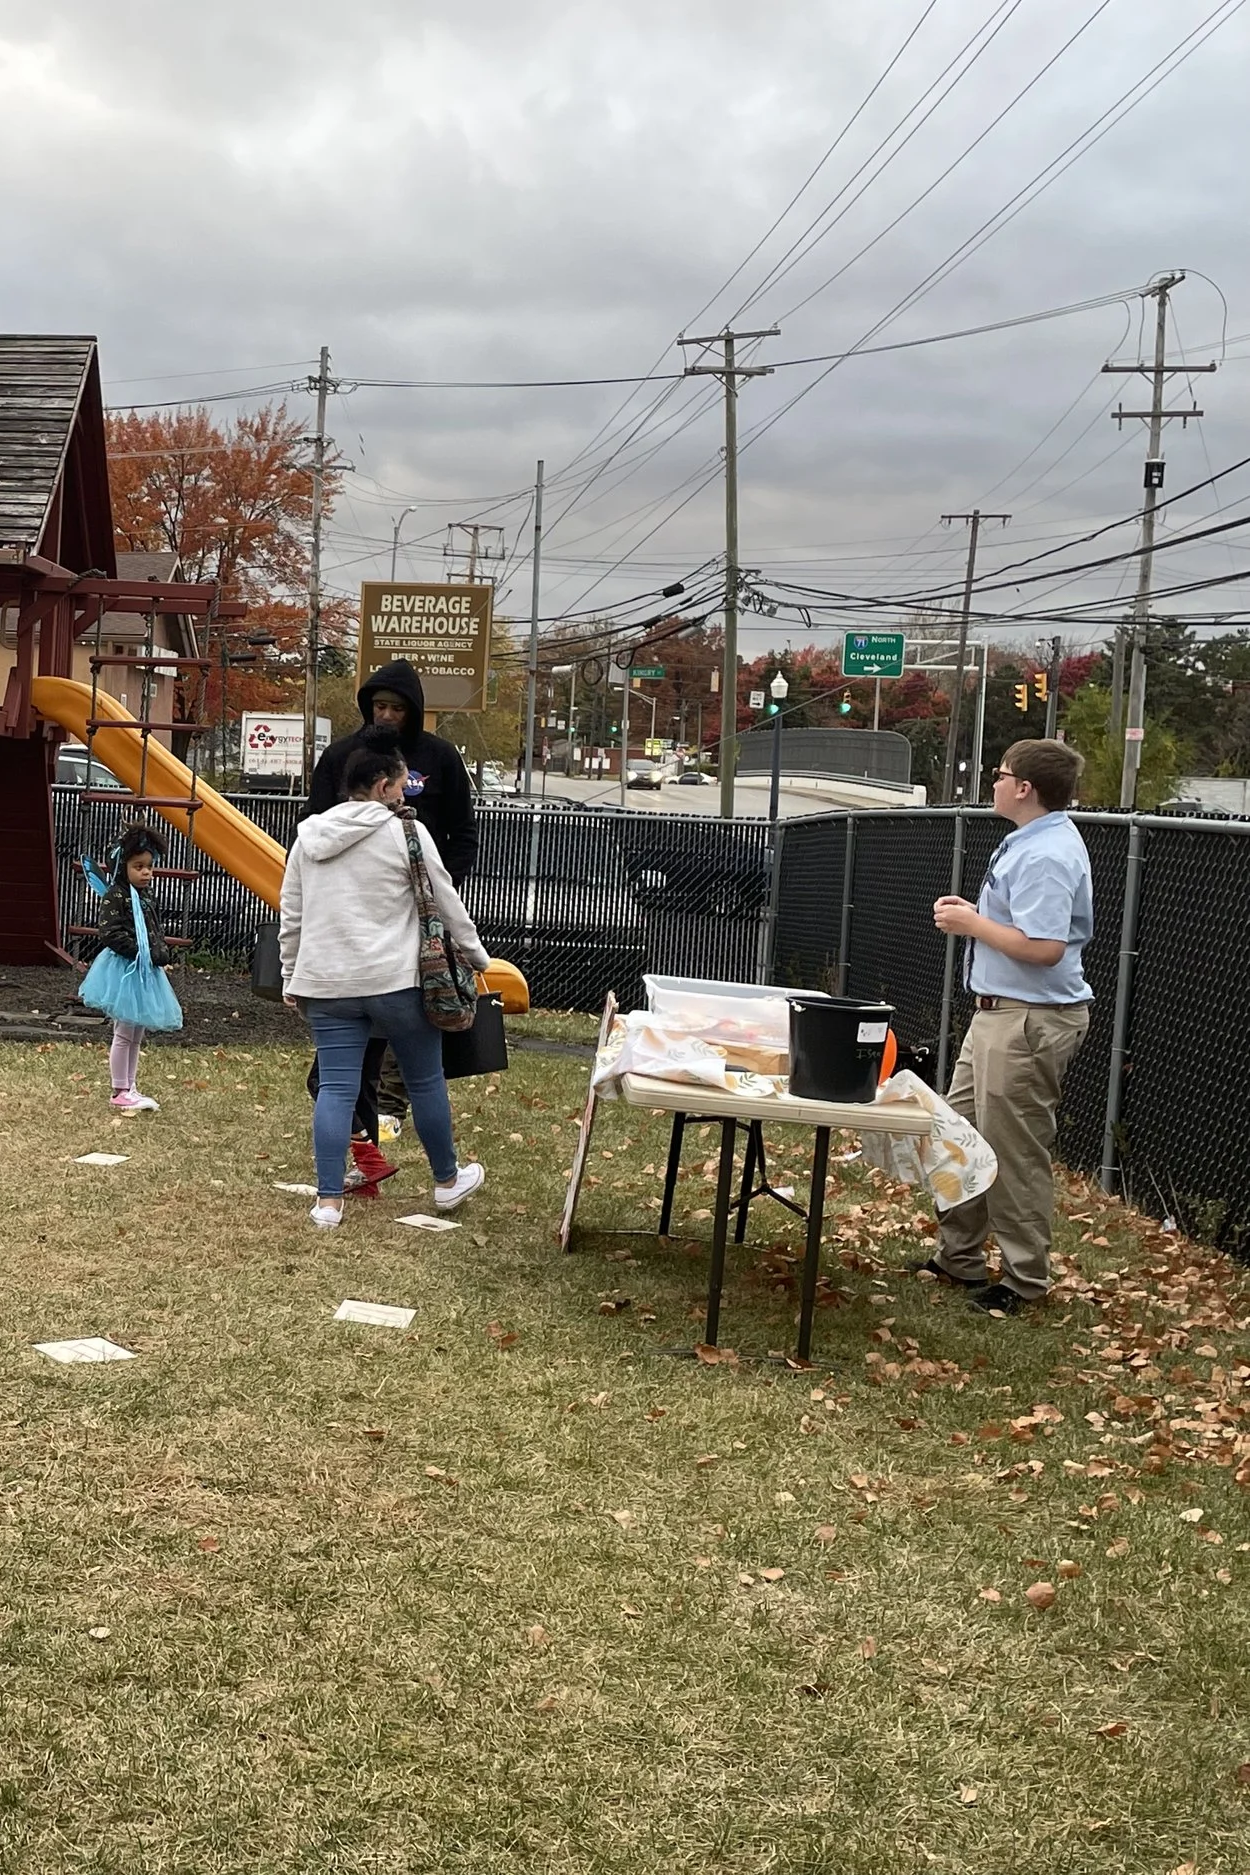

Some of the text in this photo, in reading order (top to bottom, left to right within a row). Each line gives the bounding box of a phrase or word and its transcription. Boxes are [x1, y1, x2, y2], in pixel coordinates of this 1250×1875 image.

[380, 594, 472, 614] BEVERAGE
[370, 614, 480, 635] WAREHOUSE
[374, 639, 400, 647] STATE
[391, 653, 455, 663] BEER WINE
[850, 652, 898, 661] Cleveland
[425, 666, 475, 676] TOBACCO
